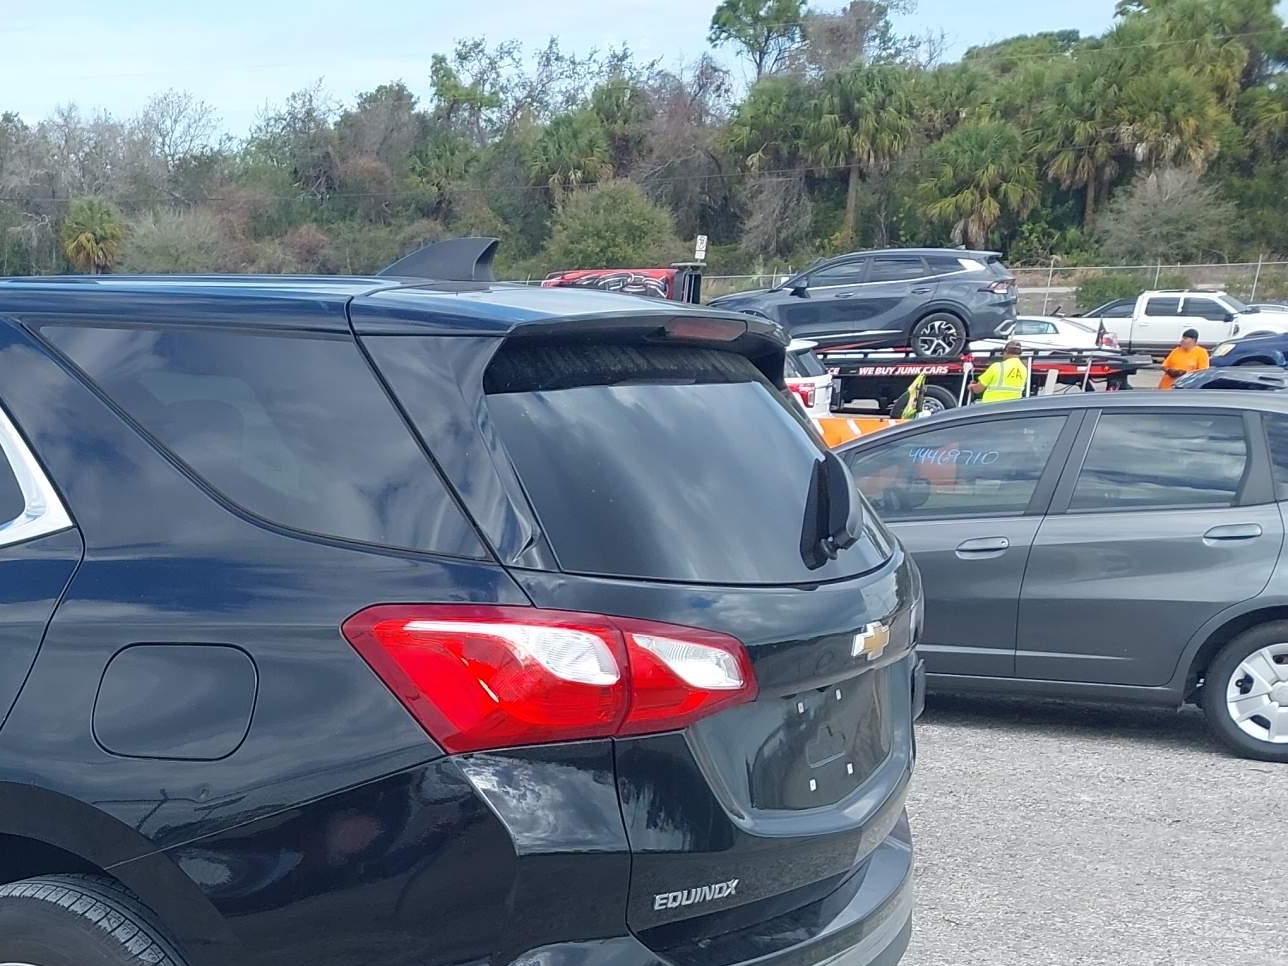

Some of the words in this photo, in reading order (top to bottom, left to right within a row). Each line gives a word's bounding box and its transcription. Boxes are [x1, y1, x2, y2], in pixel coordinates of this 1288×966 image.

[859, 367, 874, 375] WE
[875, 367, 895, 375] BUY
[895, 366, 921, 375] JUNK
[922, 365, 949, 375] CARS
[653, 878, 740, 911] EQUINOX
